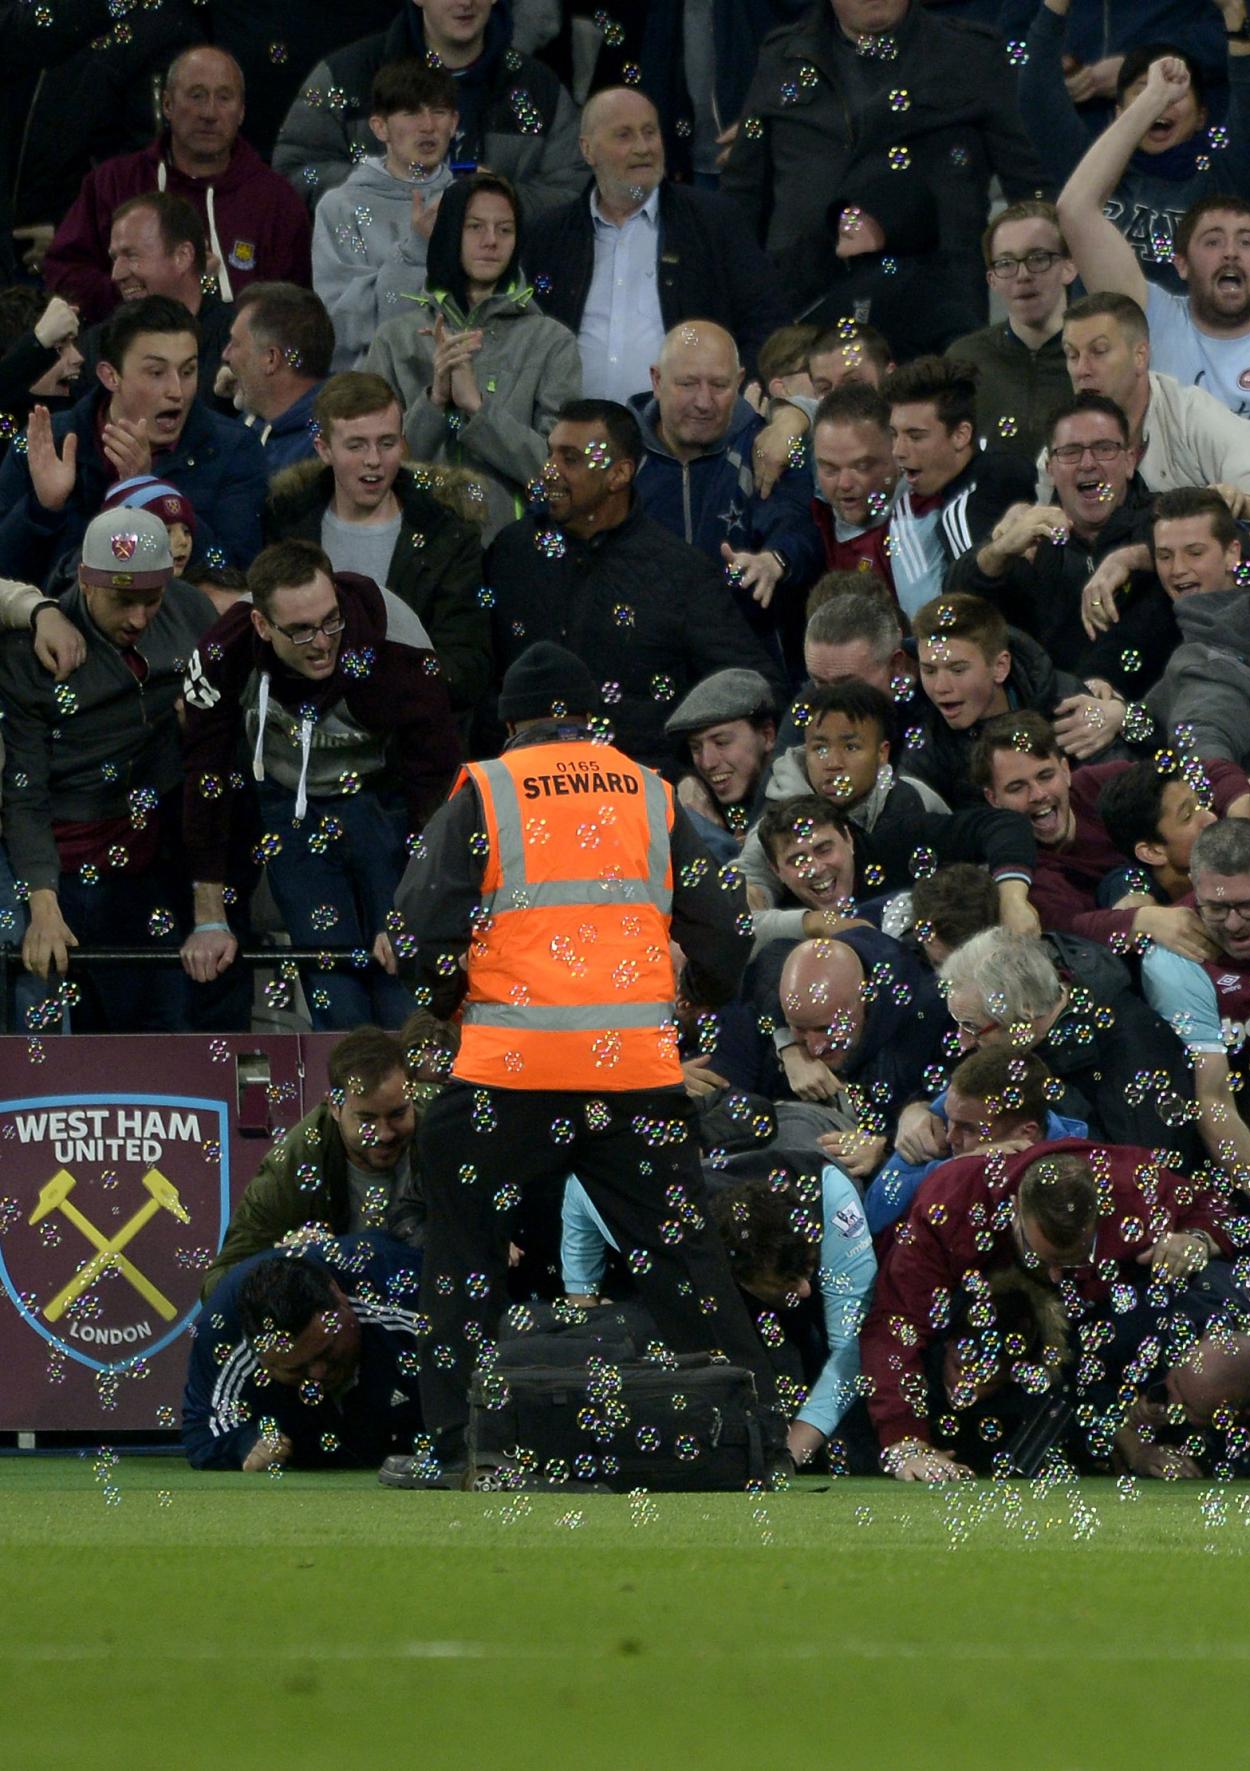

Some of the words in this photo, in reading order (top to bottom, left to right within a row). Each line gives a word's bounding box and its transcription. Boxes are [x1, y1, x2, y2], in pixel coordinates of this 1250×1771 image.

[556, 761, 600, 772] 0165
[523, 772, 639, 799] STEWARD
[16, 1109, 110, 1143] WEST
[117, 1110, 202, 1143] HAM
[55, 1138, 163, 1164] UNITED
[69, 1321, 153, 1345] LONDON
